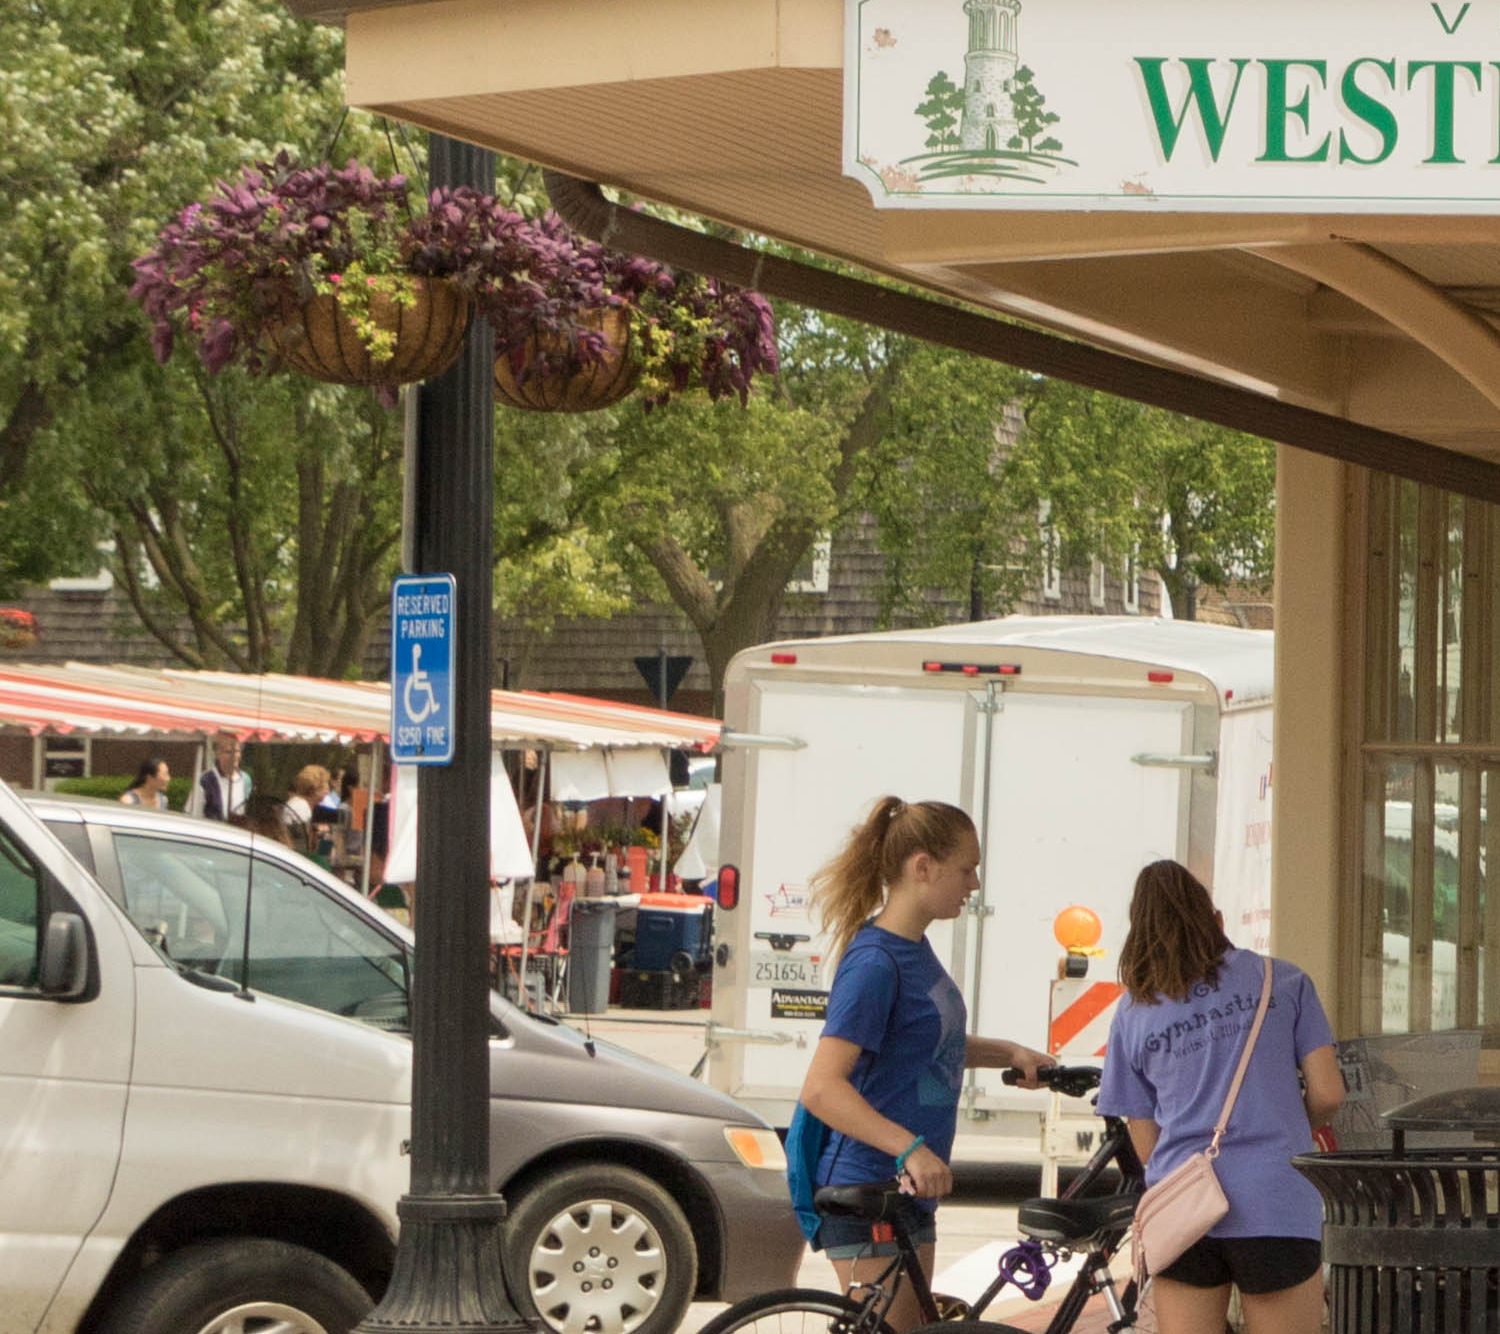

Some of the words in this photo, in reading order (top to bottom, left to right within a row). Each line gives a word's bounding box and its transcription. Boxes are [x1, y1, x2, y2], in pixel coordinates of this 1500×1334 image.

[398, 594, 449, 616] RESERVED
[401, 618, 445, 639] PARKING
[397, 725, 422, 746] $250
[426, 726, 447, 746] FINE
[755, 962, 806, 982] 251654
